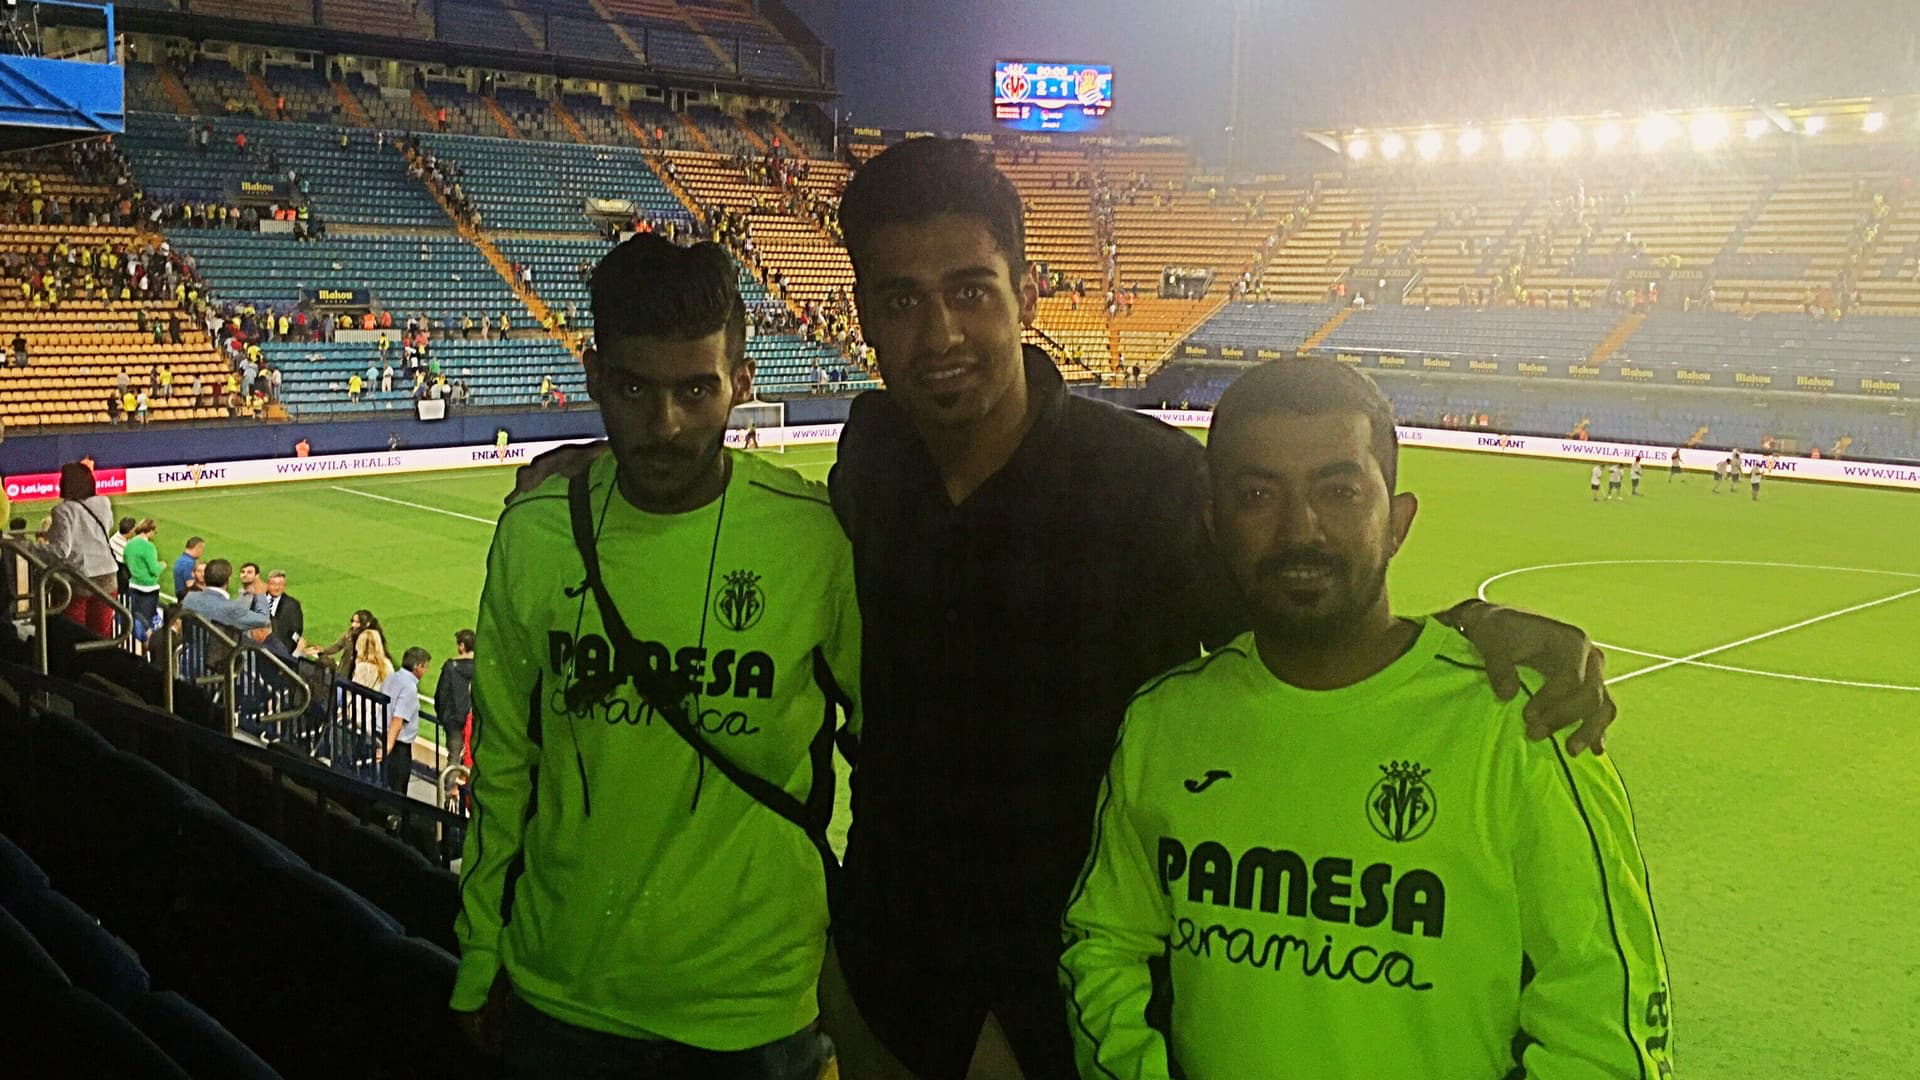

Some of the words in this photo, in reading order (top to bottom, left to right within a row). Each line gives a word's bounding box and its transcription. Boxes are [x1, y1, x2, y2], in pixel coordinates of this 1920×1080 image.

[319, 289, 353, 300] Mahou
[158, 464, 227, 485] ENDAVANT
[276, 456, 401, 474] WWW.VILA-REAL.ES
[1158, 836, 1446, 939] PAMESA
[1170, 914, 1434, 991] eramica
